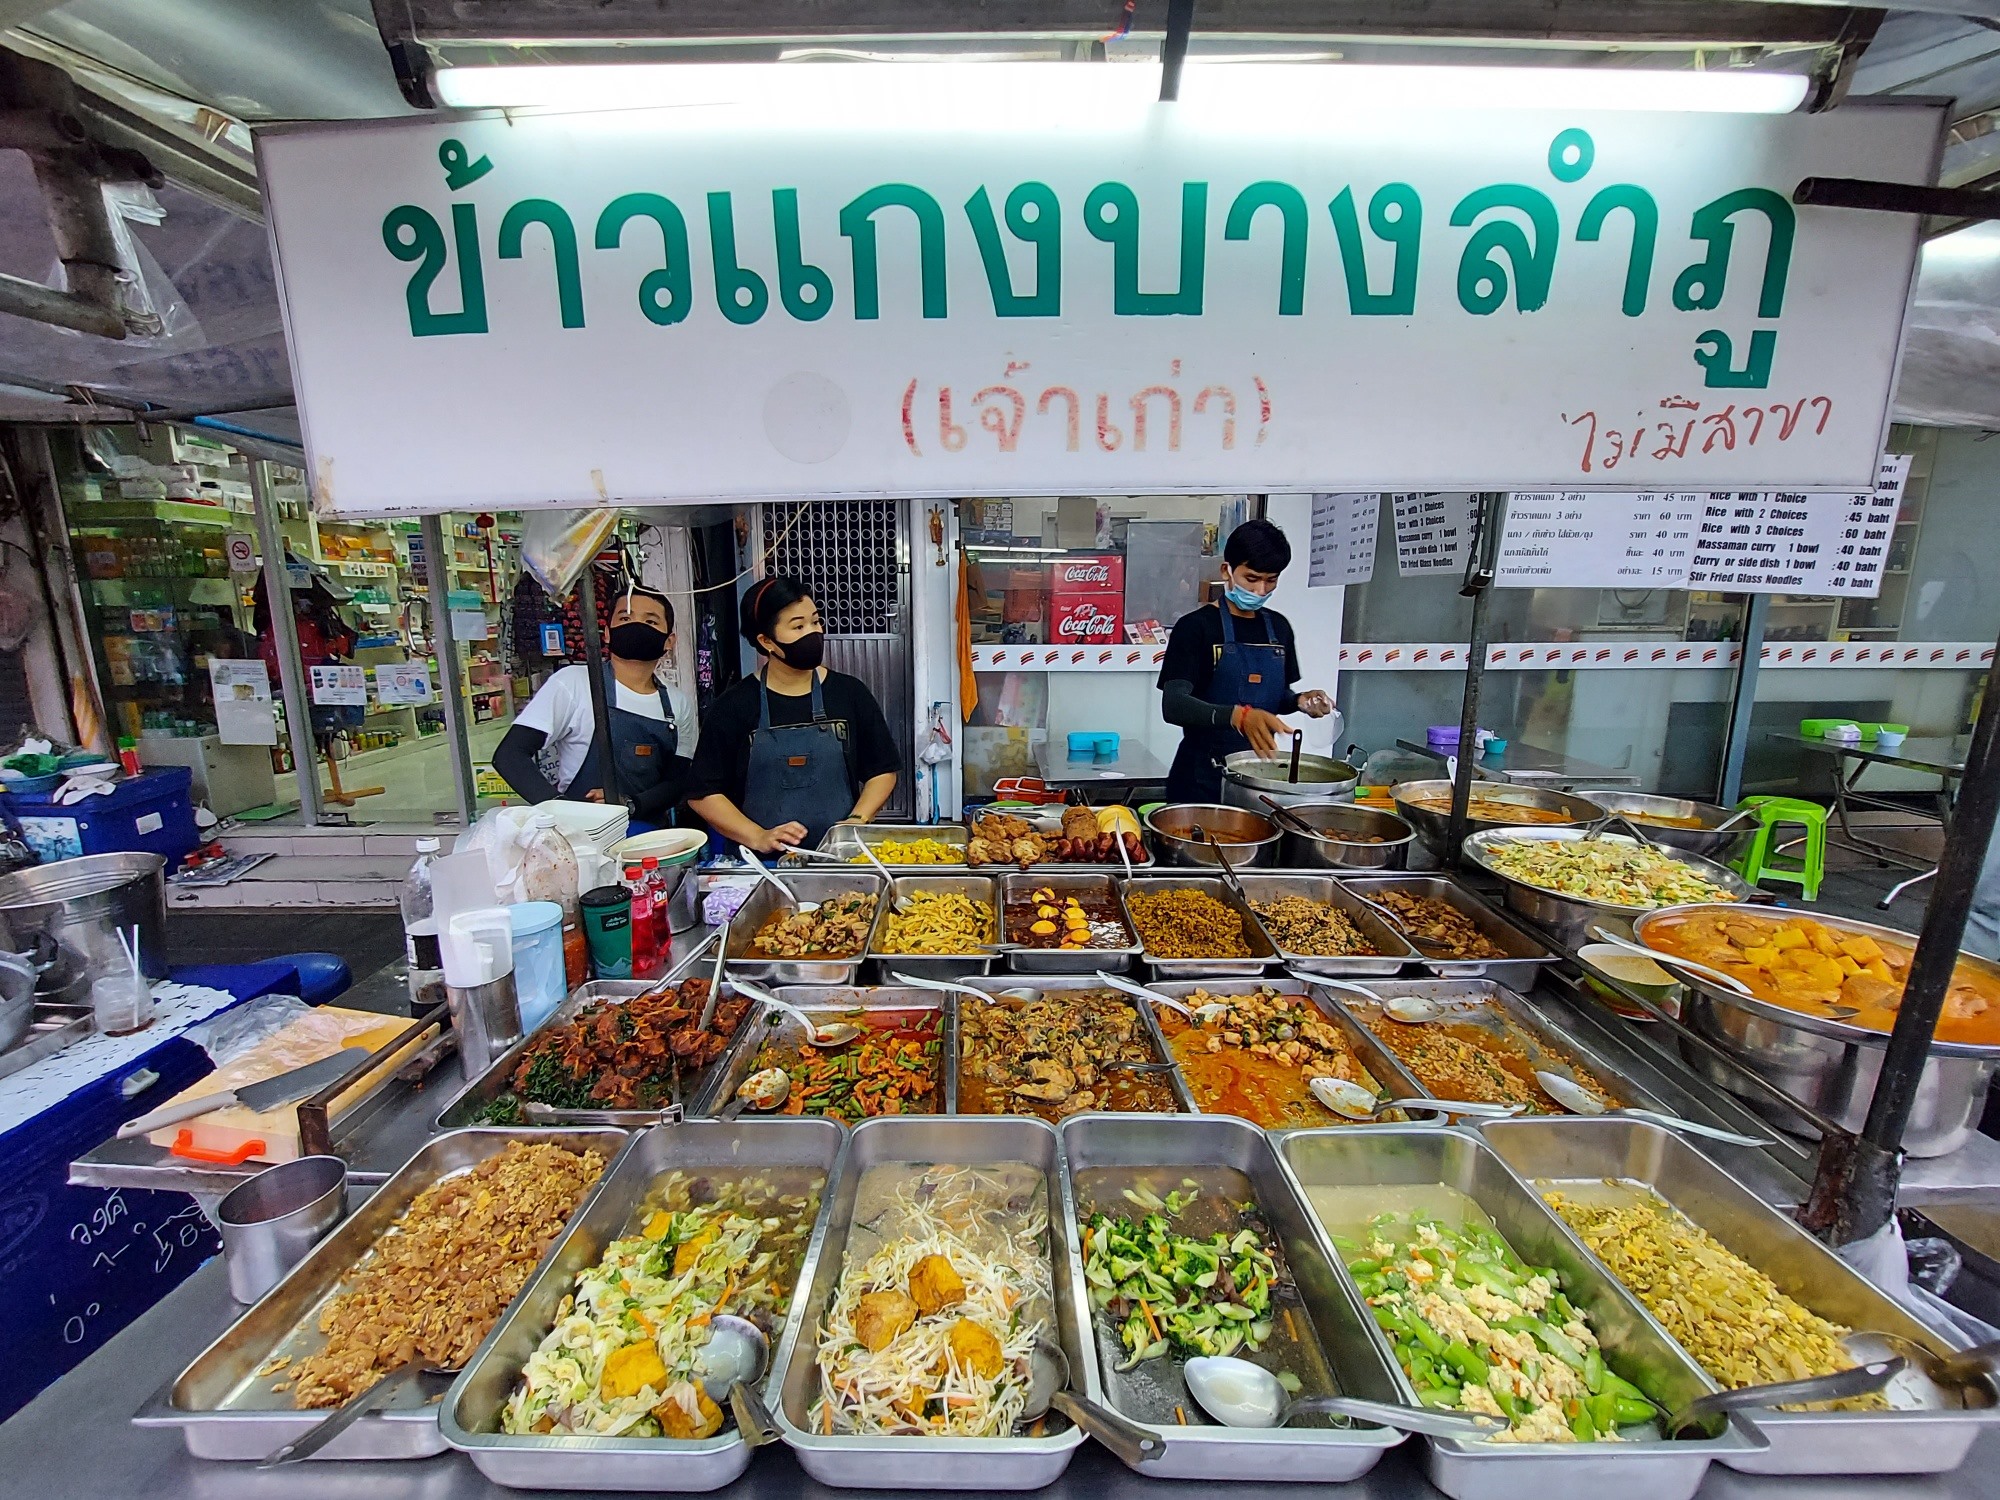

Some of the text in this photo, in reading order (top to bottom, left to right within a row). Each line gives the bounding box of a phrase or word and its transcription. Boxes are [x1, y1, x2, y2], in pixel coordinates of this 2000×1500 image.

[382, 128, 1797, 389] ข้าวแกงบางลำภู
[1663, 493, 1675, 502] 45
[1680, 494, 1696, 502] บาท
[1709, 492, 1731, 501] Rice
[1738, 492, 1758, 502] with
[1763, 493, 1769, 502] 1
[1774, 493, 1807, 504] Choice
[1871, 496, 1895, 508] baht
[1424, 501, 1445, 512] Choices
[1425, 515, 1445, 526] Choices
[1510, 510, 1692, 521] ข้าวราดแกง 3 อย่าง ราคา 60 บาท
[1705, 507, 1727, 517] Rice
[1734, 507, 1754, 518] with
[1758, 508, 1766, 519] 2
[1770, 509, 1808, 521] Choices
[1867, 512, 1890, 524] baht
[1443, 527, 1457, 538] bowl
[1532, 529, 1556, 538] กับข้าว
[1629, 531, 1647, 539] ราคา
[1655, 530, 1668, 539] 40
[1701, 522, 1723, 533] Rice
[1730, 524, 1750, 535] with
[1755, 525, 1762, 535] 3
[1766, 525, 1804, 537] Choices
[1863, 529, 1887, 540] baht
[1444, 542, 1457, 552] bowl
[1697, 539, 1748, 551] Massaman
[1750, 542, 1776, 554] curry
[1788, 542, 1795, 552] 1
[1797, 542, 1820, 554] bowl
[1858, 545, 1882, 557] baht
[1652, 549, 1664, 557] 40
[1669, 550, 1685, 558] บาท
[1693, 555, 1720, 567] Curry
[1724, 558, 1735, 567] or
[1737, 556, 1758, 568] side
[1759, 557, 1780, 569] dish
[1785, 559, 1791, 569] 1
[1793, 559, 1816, 570] bowl
[1854, 561, 1878, 573] baht
[1651, 567, 1663, 576] 15
[1667, 568, 1683, 576] บาท
[1689, 571, 1706, 582] Stir
[1709, 572, 1734, 583] Fried
[1736, 573, 1763, 584] Glass
[1765, 574, 1803, 586] Noodles
[1850, 577, 1874, 589] baht
[1059, 614, 1117, 636] Coca-Cola
